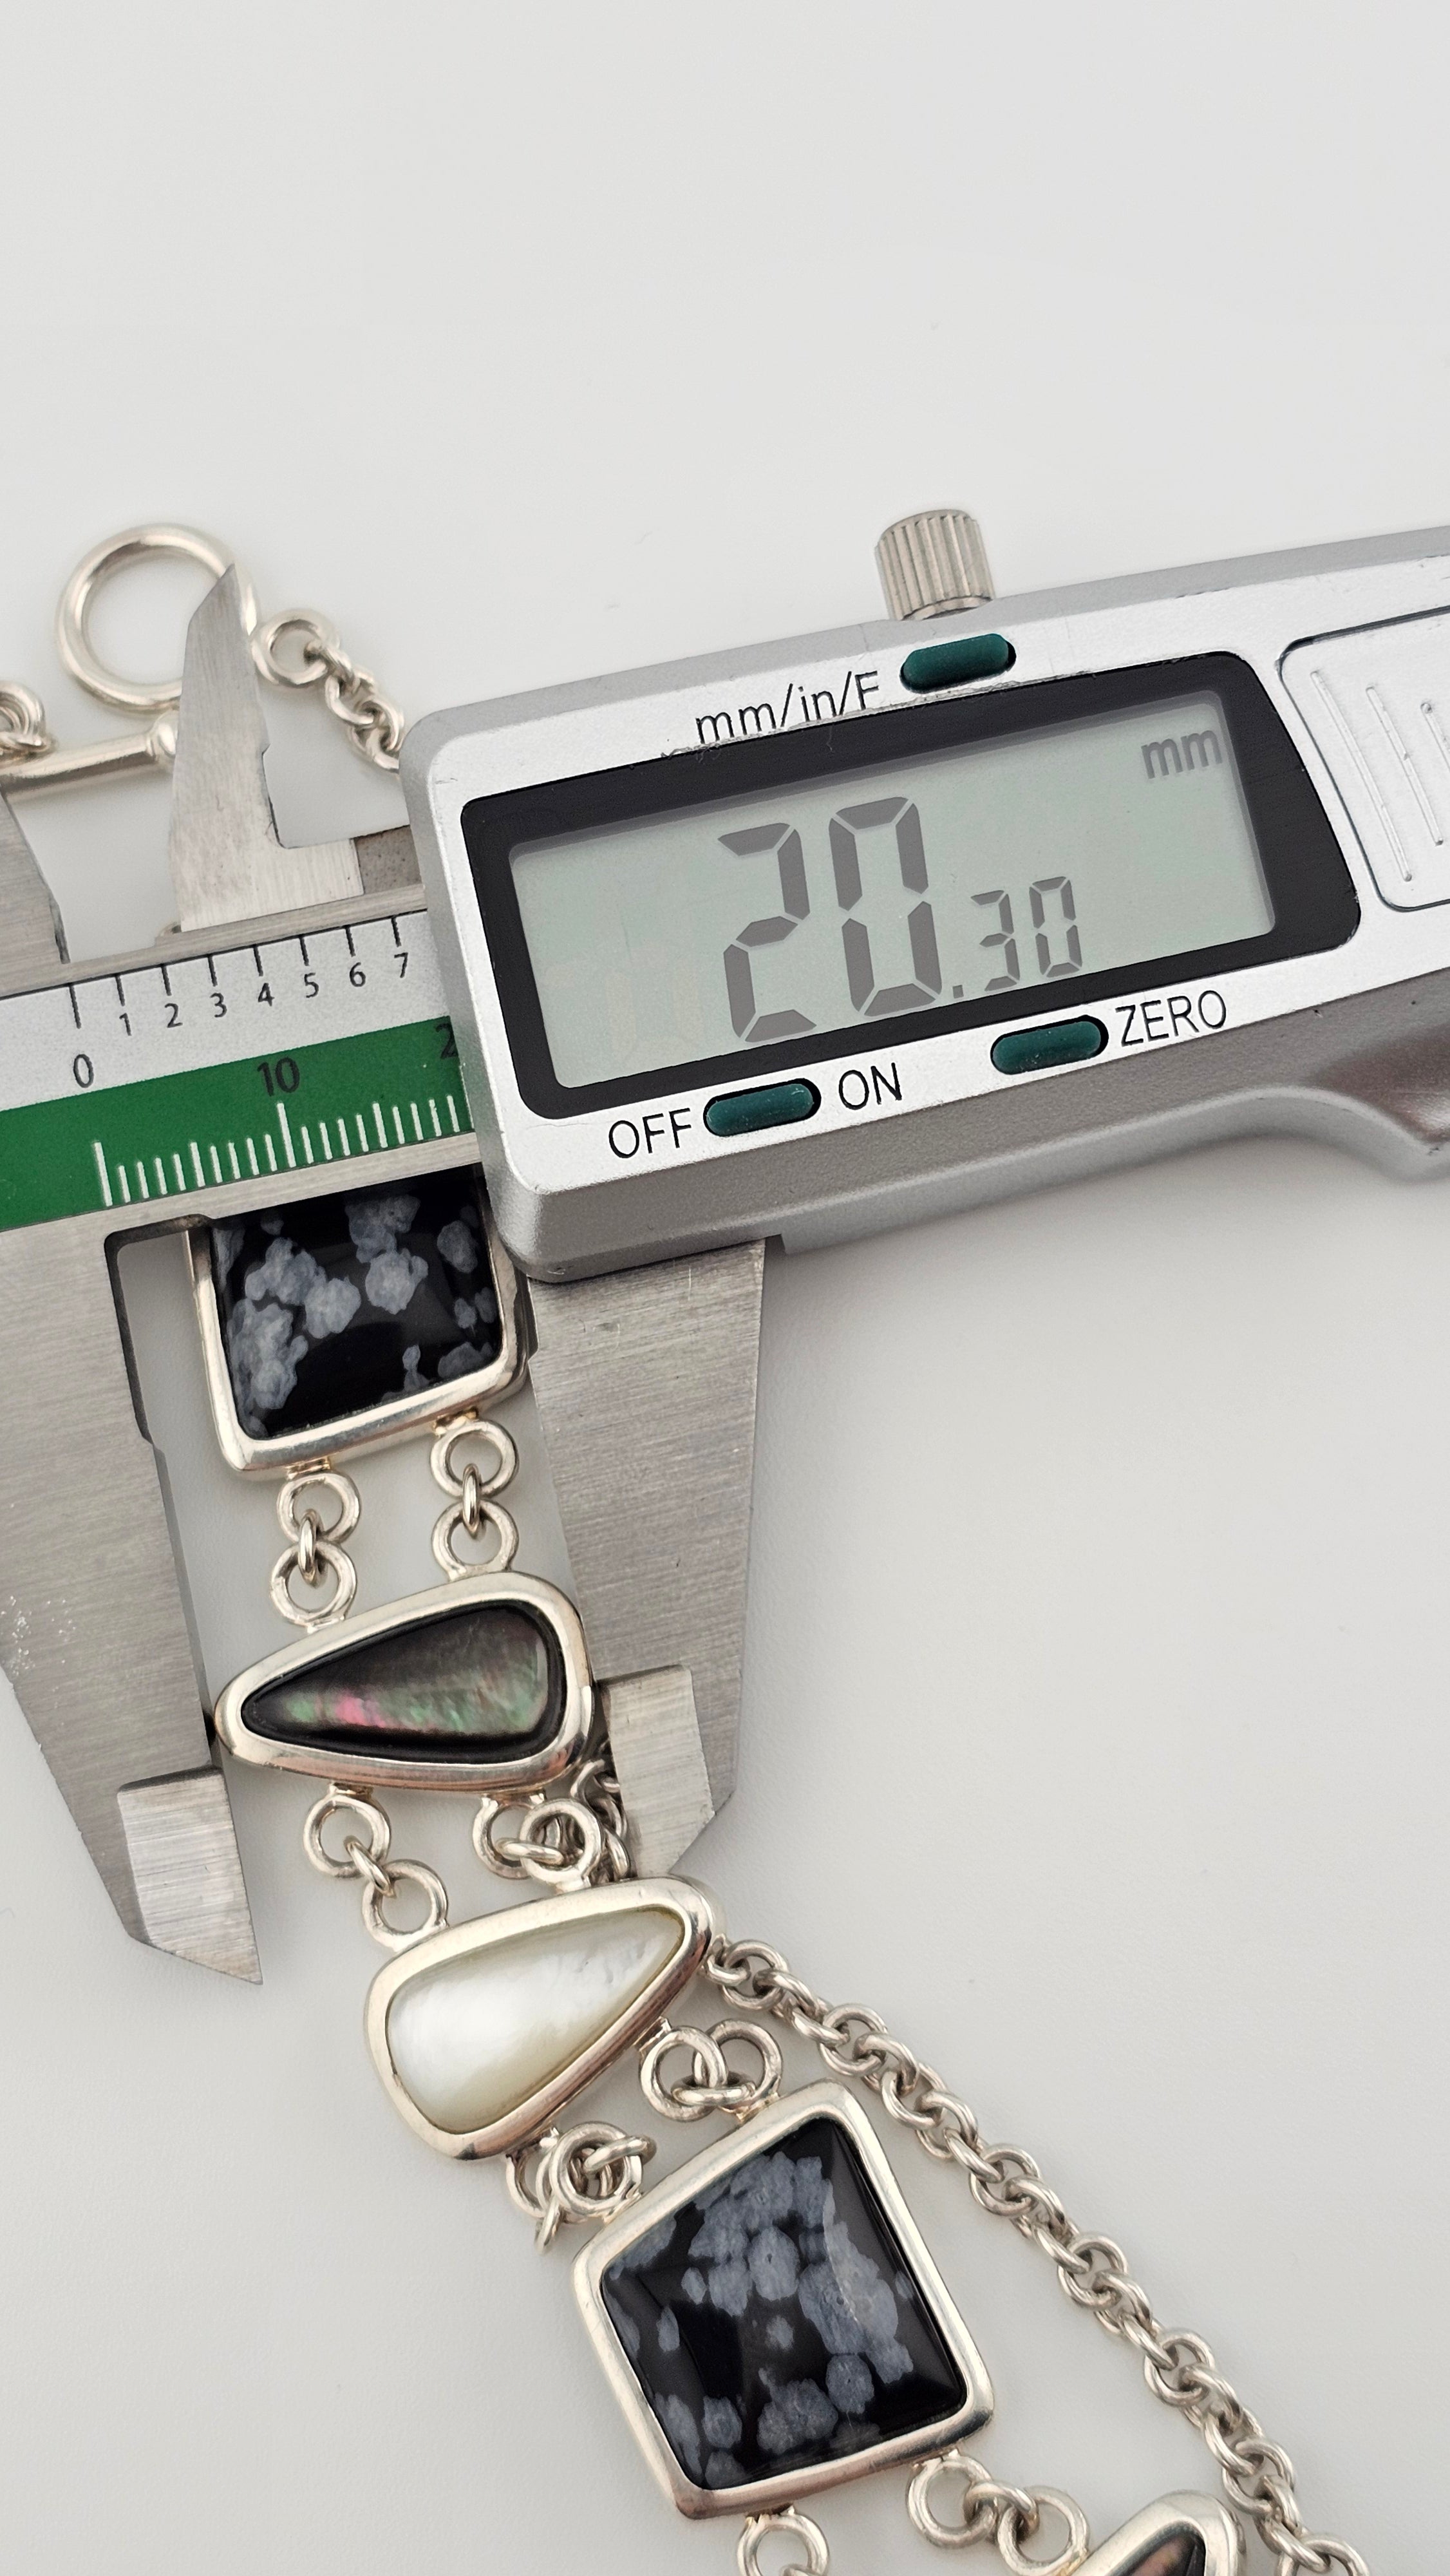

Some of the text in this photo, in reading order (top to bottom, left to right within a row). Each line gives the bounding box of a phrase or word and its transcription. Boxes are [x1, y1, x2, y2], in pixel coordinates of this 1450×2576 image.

[695, 671, 880, 744] mm/in/F
[1140, 728, 1223, 780] mm
[717, 796, 1083, 1043] 20.30
[73, 952, 410, 1088] 0 1 2 3 4 5 6 7
[1115, 989, 1227, 1048] ZERO
[258, 1056, 301, 1097] 10
[838, 1062, 902, 1111] ON
[608, 1108, 693, 1159] OFF
